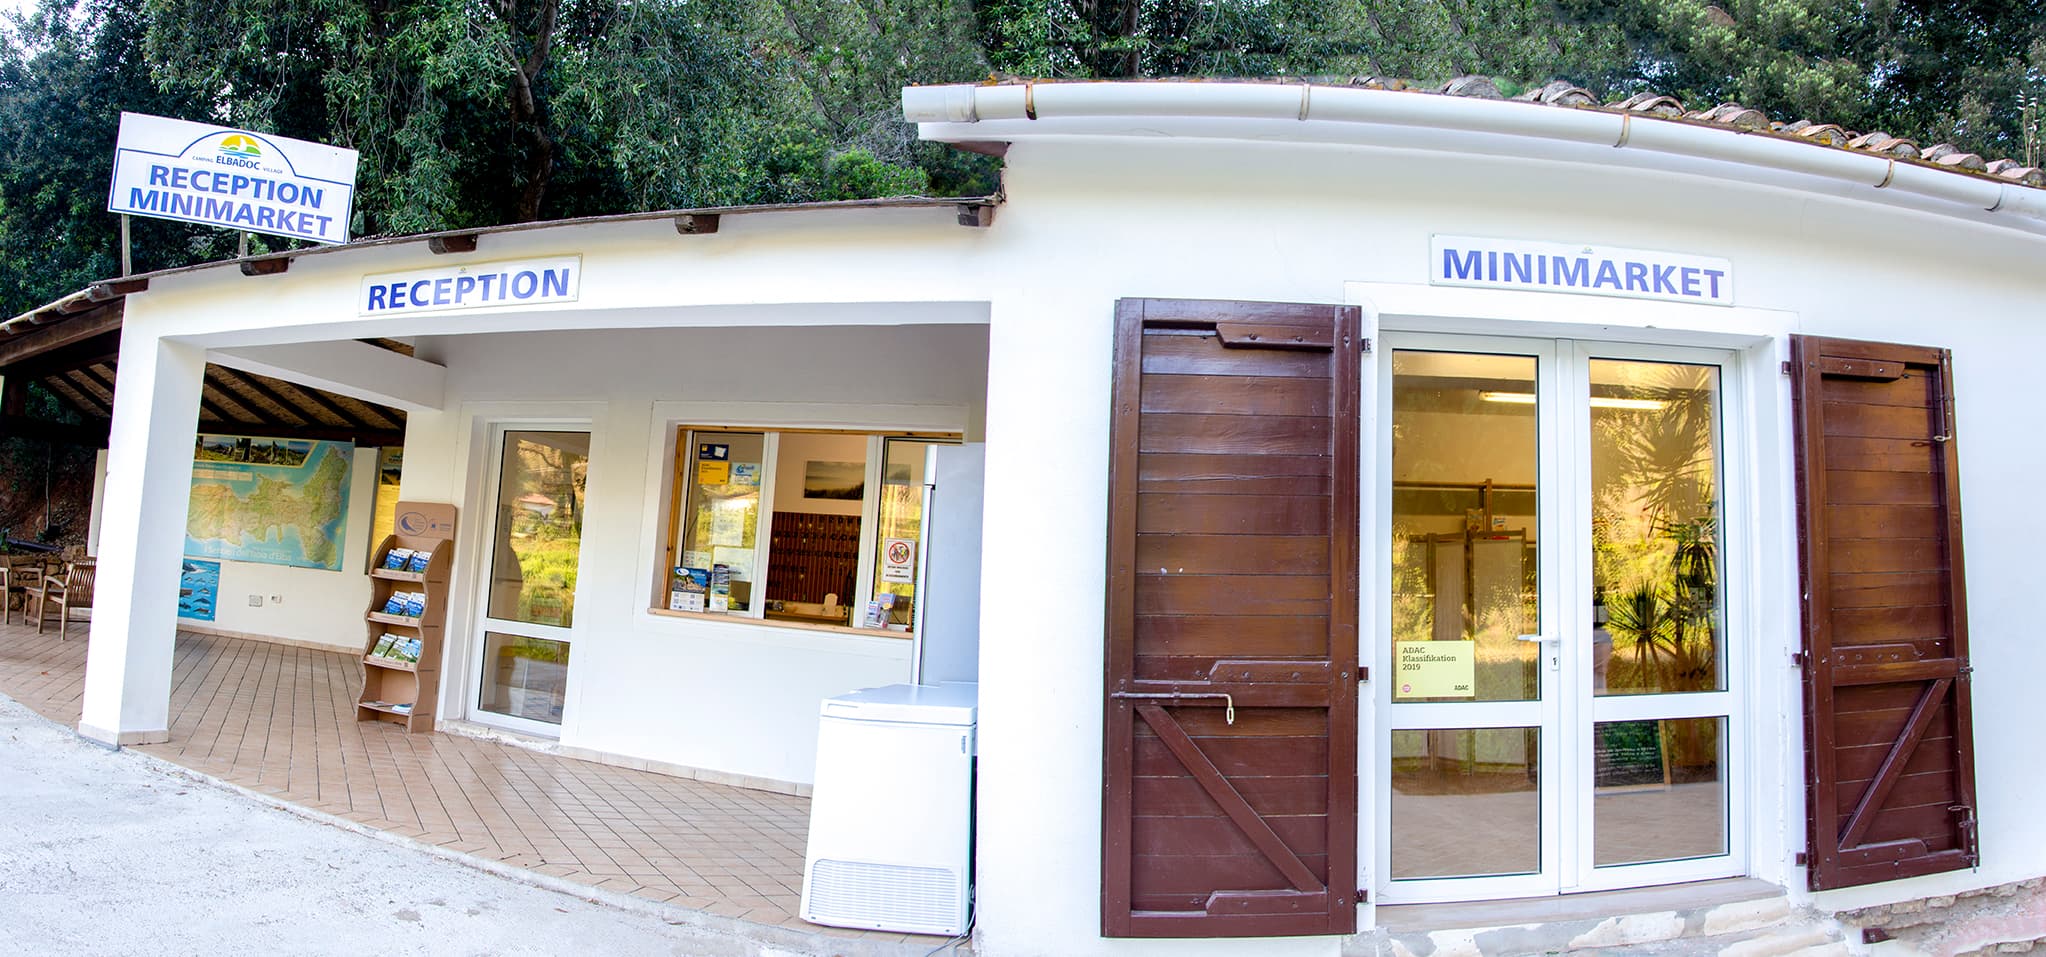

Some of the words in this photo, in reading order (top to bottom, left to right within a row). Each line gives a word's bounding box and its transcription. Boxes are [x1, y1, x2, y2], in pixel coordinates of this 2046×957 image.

[192, 155, 214, 163] CAMPING
[215, 155, 261, 171] ELBADOC
[149, 164, 324, 208] RECEPTION
[129, 187, 332, 236] MINIMARKET
[367, 268, 570, 312] RECEPTION
[1443, 248, 1725, 299] MINIMARKET
[1402, 663, 1421, 671] 2019
